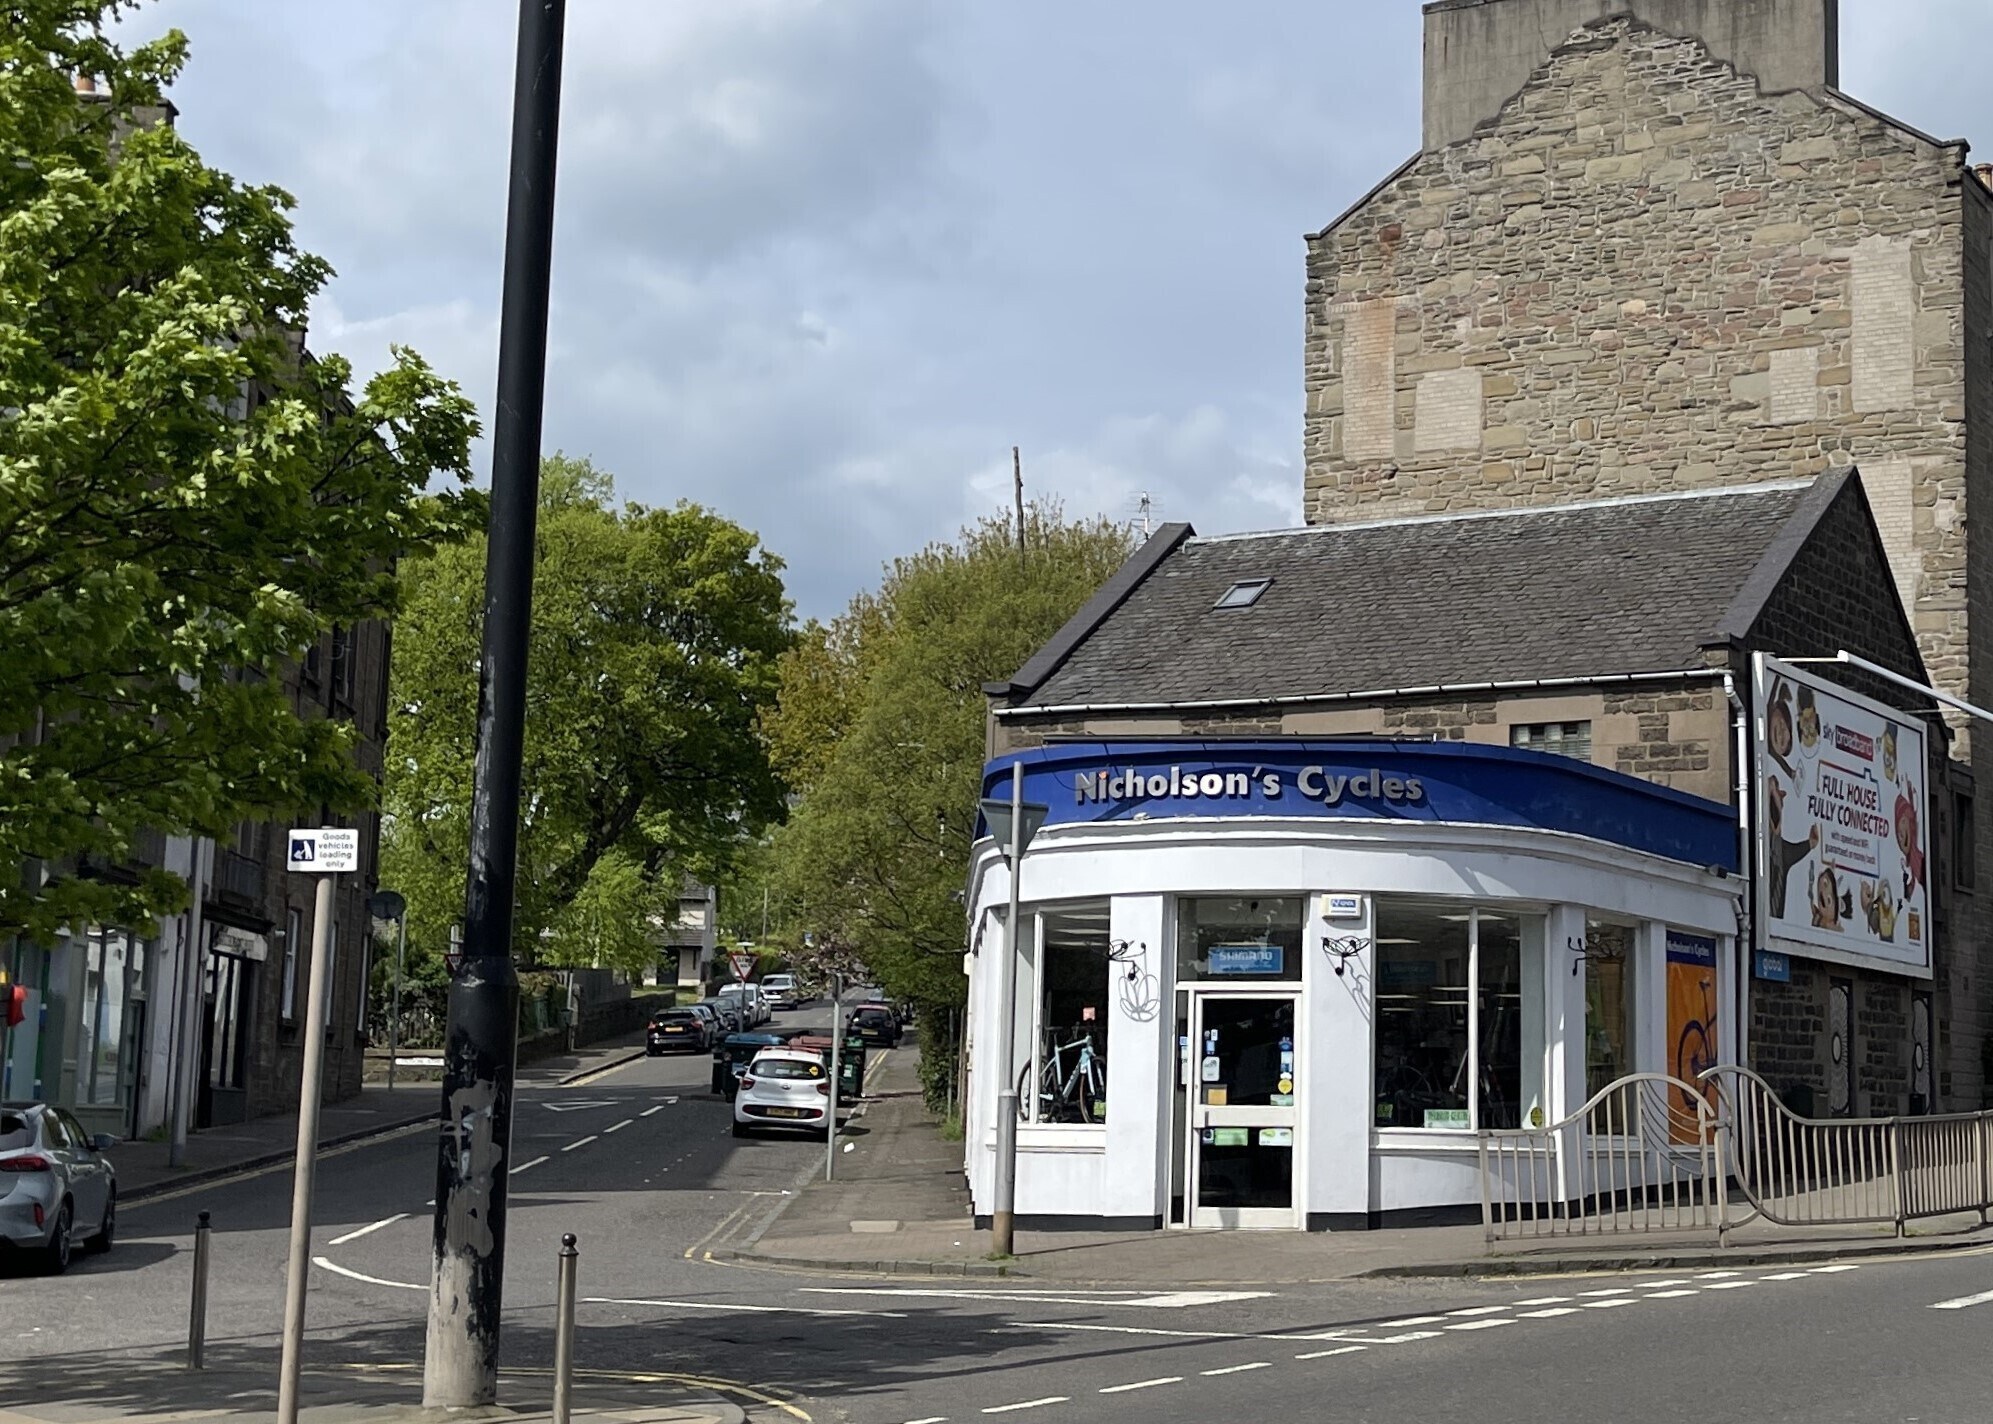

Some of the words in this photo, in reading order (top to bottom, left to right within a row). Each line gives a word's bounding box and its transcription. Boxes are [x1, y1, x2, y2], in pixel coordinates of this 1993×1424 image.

[1823, 722, 1834, 745] sky
[1075, 765, 1281, 802] Nicholson's
[1297, 765, 1424, 804] Cycles
[1822, 775, 1845, 800] FULL
[1847, 783, 1877, 810] HOUSE
[1808, 795, 1836, 821] FULLY
[1838, 804, 1889, 838] CONNECTED
[319, 851, 352, 859] loading
[1219, 951, 1273, 961] SHIMANO
